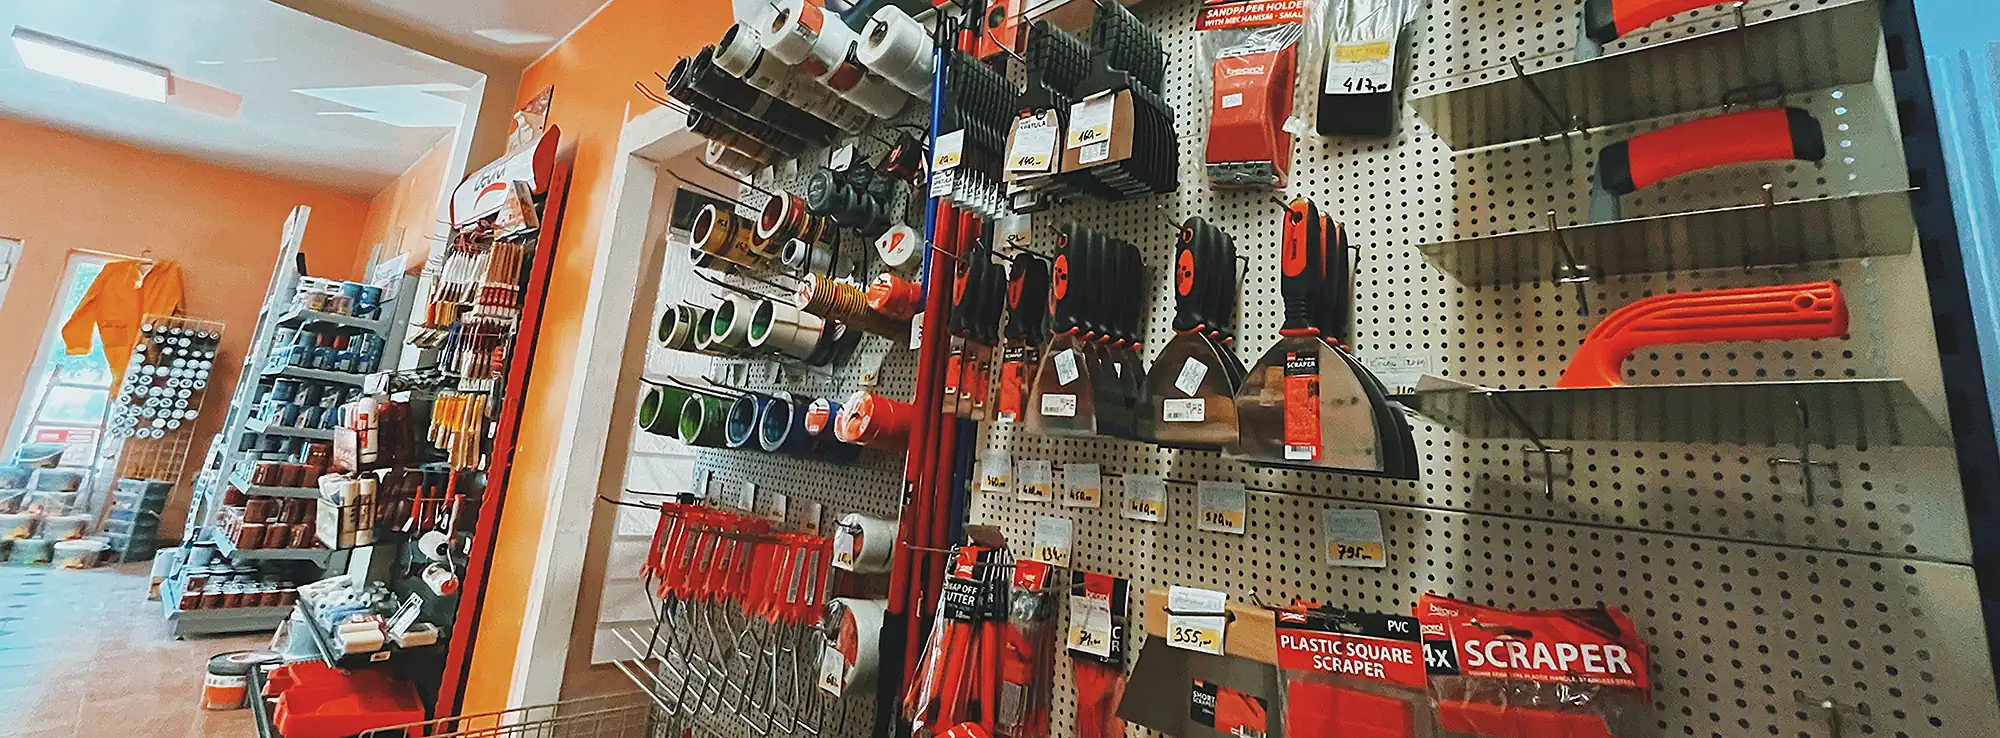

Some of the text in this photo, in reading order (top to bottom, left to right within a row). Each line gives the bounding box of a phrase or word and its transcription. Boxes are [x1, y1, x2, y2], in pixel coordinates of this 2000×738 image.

[1206, 1, 1303, 18] SANDPAPER HOLDE
[1204, 11, 1303, 27] WITH MECHANISM SMAL
[1286, 360, 1316, 369] SCRAPER
[962, 584, 978, 595] OFF
[1387, 620, 1409, 633] PVC
[1280, 635, 1414, 665] PLASTIC SQUARE
[1464, 640, 1633, 674] SCRAPER
[1313, 655, 1386, 679] SCRAPER
